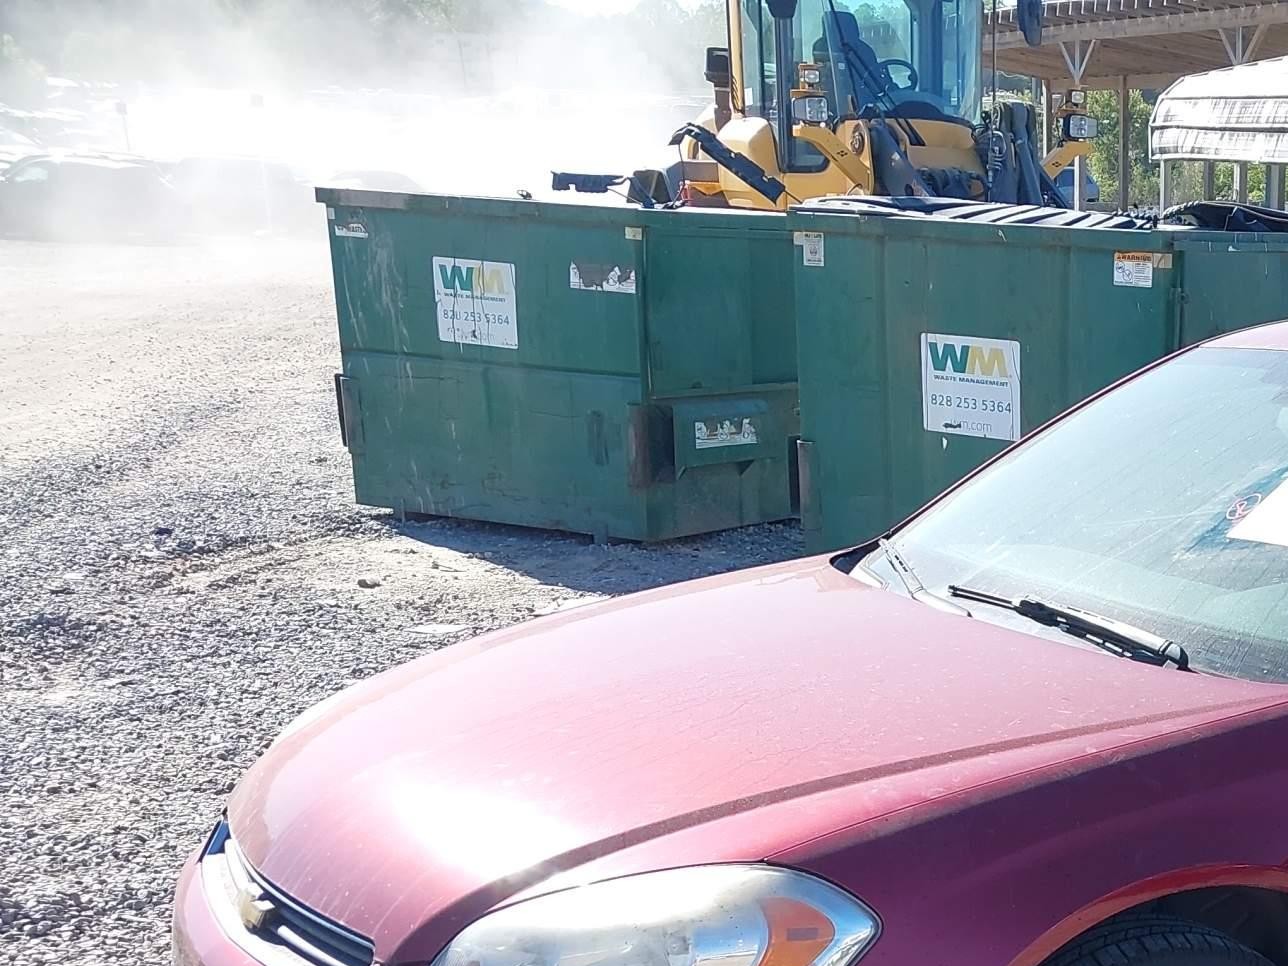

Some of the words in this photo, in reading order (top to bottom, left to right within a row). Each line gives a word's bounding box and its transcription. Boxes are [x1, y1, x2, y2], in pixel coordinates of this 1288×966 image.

[438, 264, 508, 294] WM
[463, 311, 481, 322] 253
[485, 313, 510, 325] 5364
[928, 341, 1009, 378] WM
[933, 374, 957, 382] WASTE
[959, 377, 1009, 387] MANAGEMENT
[930, 393, 953, 407] 828
[956, 396, 978, 410] 253
[981, 399, 1012, 414] 5364
